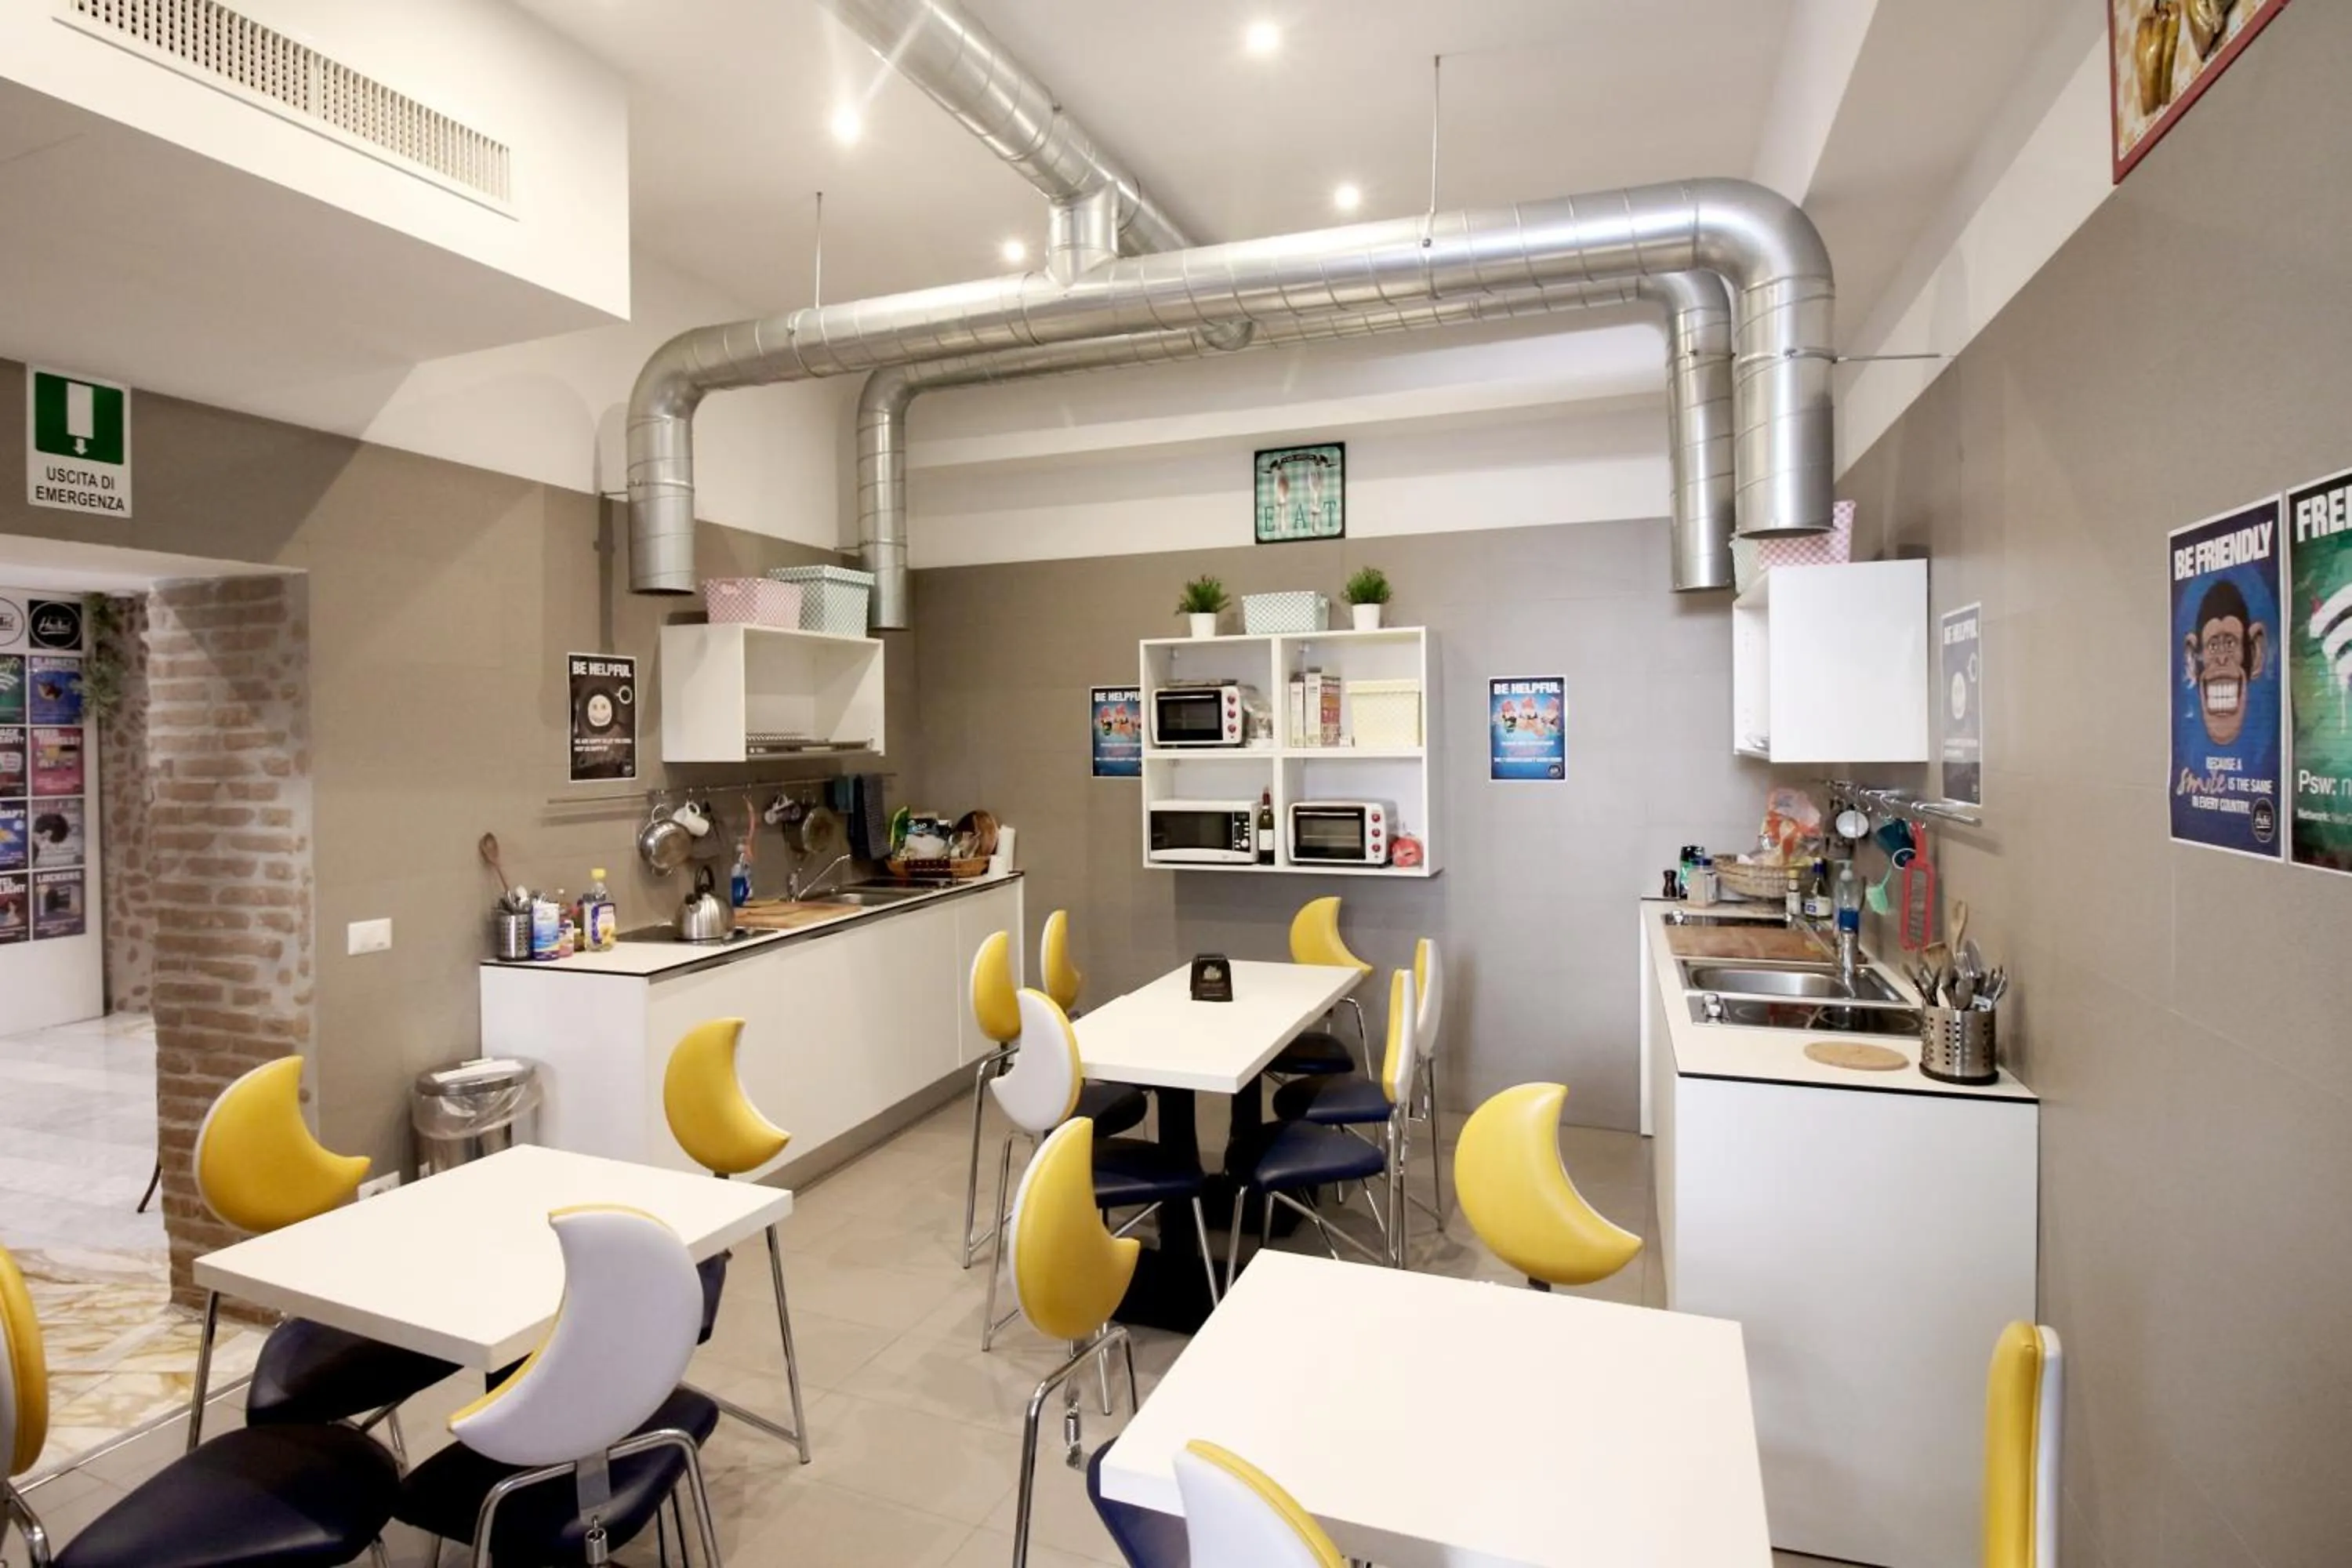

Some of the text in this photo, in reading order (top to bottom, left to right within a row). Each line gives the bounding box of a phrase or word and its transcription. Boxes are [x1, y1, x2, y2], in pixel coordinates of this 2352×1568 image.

[45, 466, 115, 490] USCITA DI
[35, 485, 125, 511] EMERGENZA
[1264, 500, 1337, 532] EAT
[2174, 521, 2274, 580] BE FRIENDLY
[572, 661, 632, 677] BE HELPFUL
[1094, 691, 1141, 702] BE HELPFU
[1494, 682, 1561, 695] BE HELPFUL
[2206, 757, 2236, 771] BECAUSE
[2227, 777, 2235, 791] IS
[2237, 778, 2249, 792] THE
[2251, 779, 2273, 794] SAME
[2298, 770, 2337, 796] Psw:
[2199, 797, 2219, 810] EVERY
